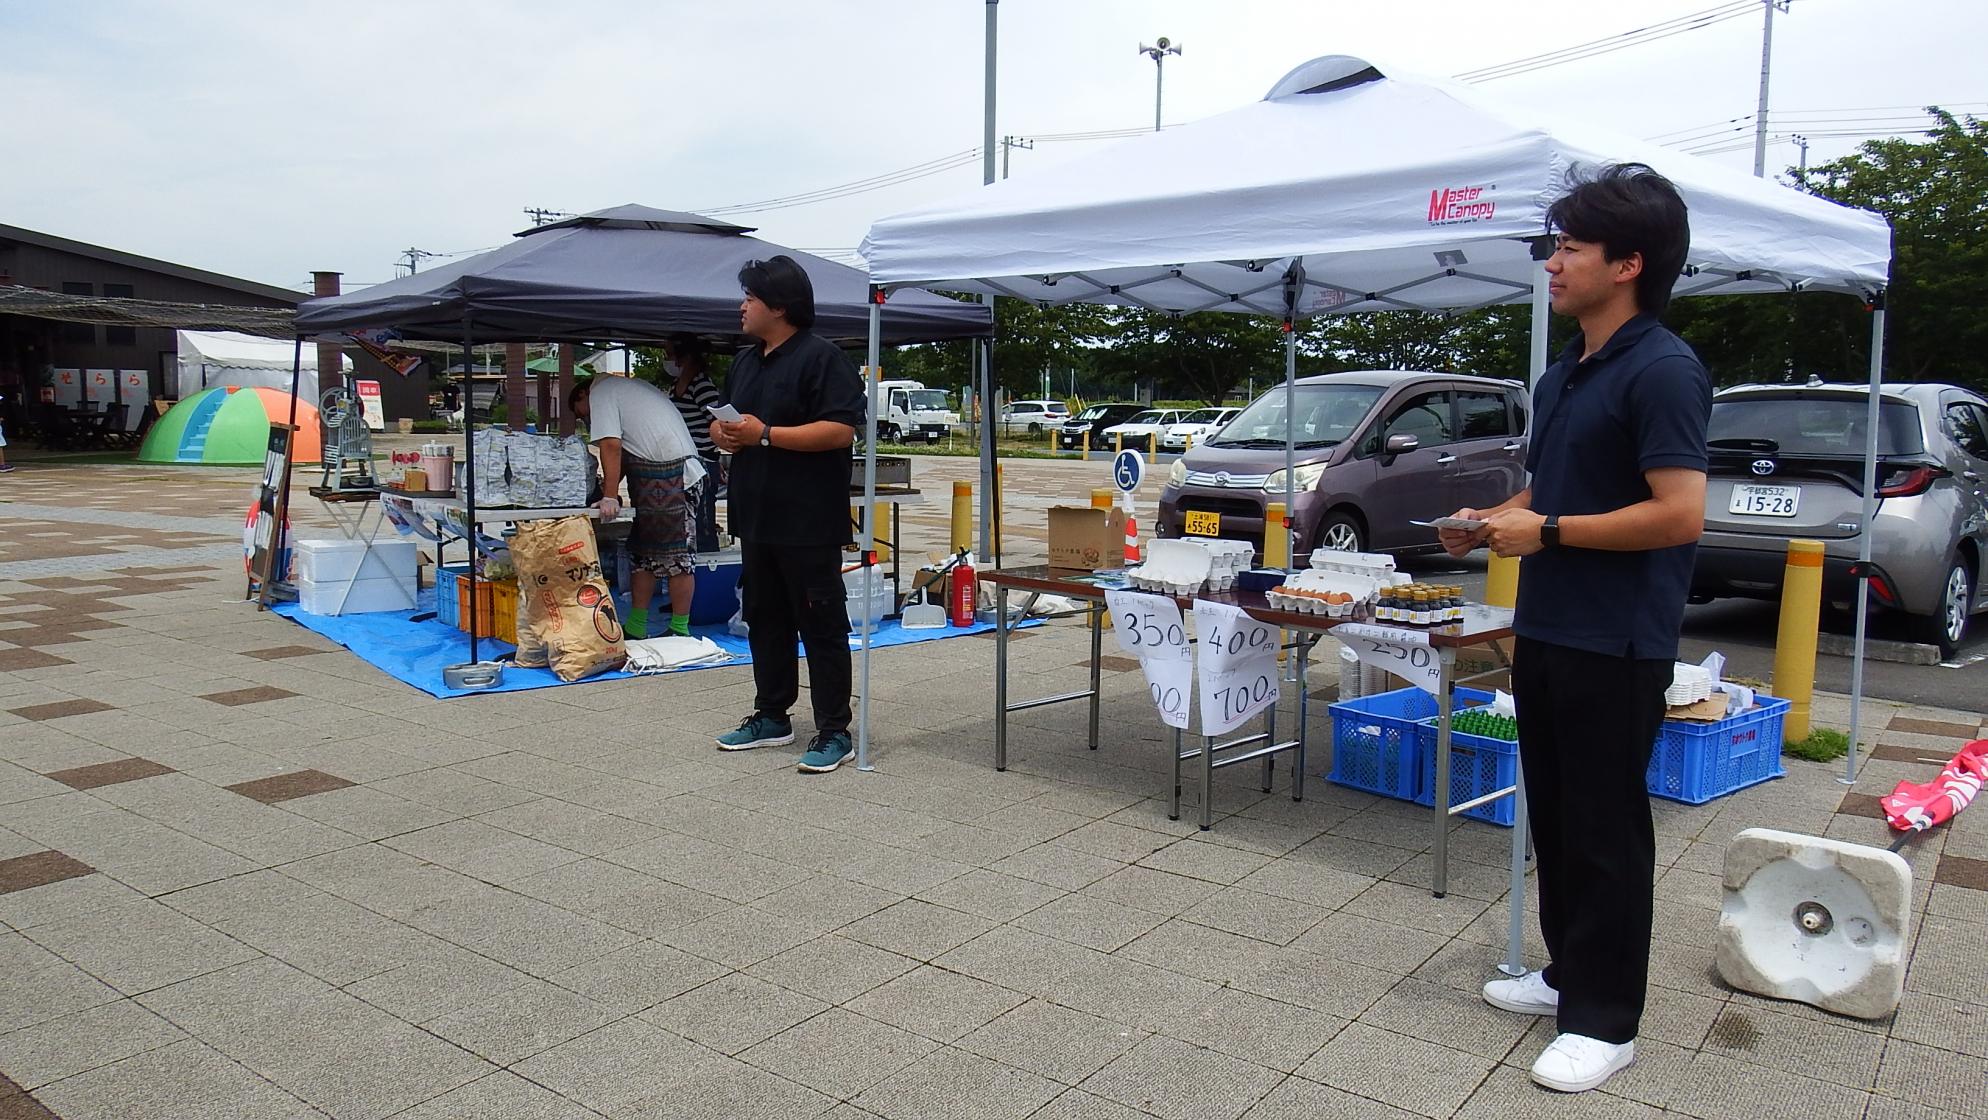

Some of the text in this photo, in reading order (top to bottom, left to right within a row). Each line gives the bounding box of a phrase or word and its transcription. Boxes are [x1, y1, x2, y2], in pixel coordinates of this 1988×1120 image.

[1428, 186, 1483, 221] Master
[1448, 202, 1495, 220] Canopy
[1746, 496, 1794, 513] 15-28
[1192, 520, 1217, 534] 55-65
